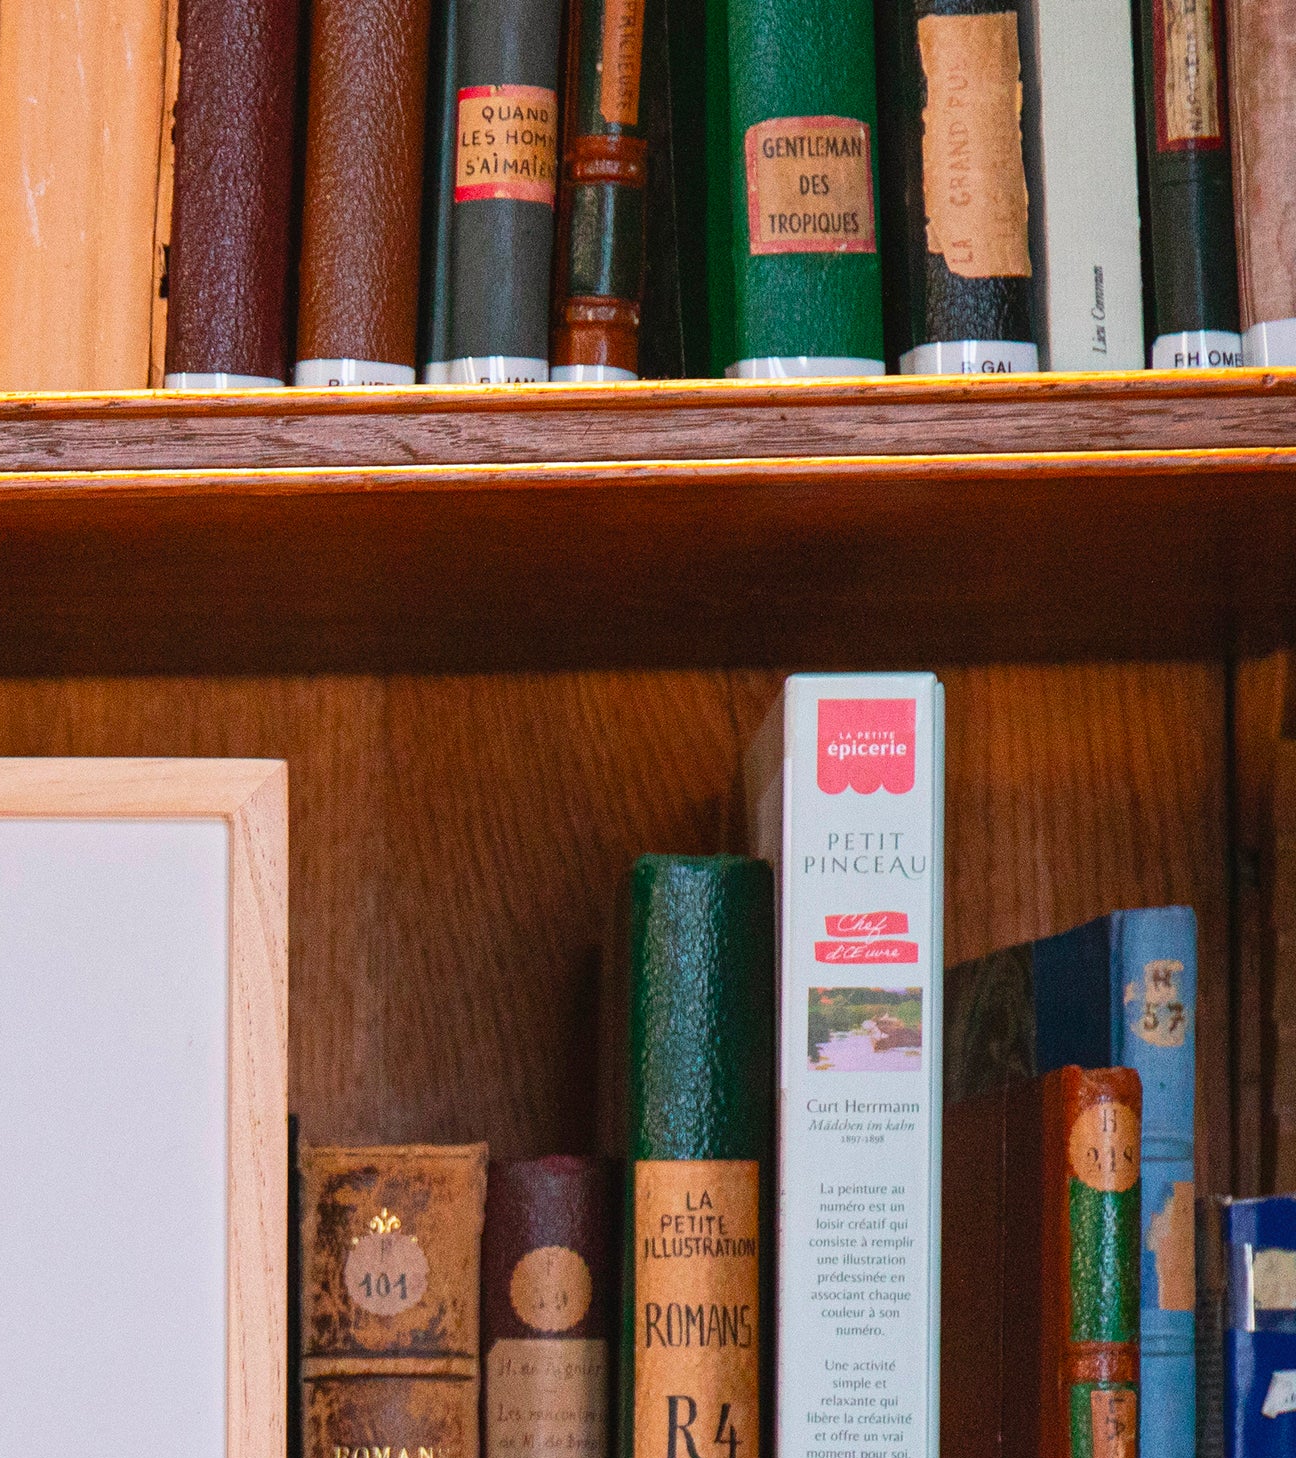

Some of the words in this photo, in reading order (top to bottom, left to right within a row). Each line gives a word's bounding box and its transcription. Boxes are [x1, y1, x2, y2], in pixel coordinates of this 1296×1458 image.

[482, 106, 548, 124] QUAND
[462, 130, 495, 147] LES
[763, 137, 863, 158] GENTLEMAN
[799, 174, 830, 195] DES
[768, 212, 859, 234] TROPIQUES
[857, 731, 895, 740] PETITE
[827, 740, 907, 761] épicerie
[828, 832, 904, 851] PETIT
[804, 855, 926, 880] PINCEAU
[837, 913, 888, 944] Chef
[806, 1099, 839, 1114] Curt
[845, 1099, 920, 1113] Herrmann
[807, 1118, 864, 1132] Mädchen
[867, 1120, 883, 1132] im
[886, 1119, 916, 1132] kahn
[840, 1134, 885, 1144] 1897-1898
[820, 1183, 834, 1194] La
[838, 1183, 888, 1197] peinture
[891, 1185, 905, 1195] au
[685, 1190, 713, 1212] LA
[819, 1201, 865, 1212] numéro
[869, 1203, 886, 1212] est
[890, 1203, 905, 1212] un
[660, 1215, 728, 1236] PETITE
[816, 1219, 844, 1229] loisir
[848, 1219, 886, 1230] créatif
[889, 1219, 908, 1232] qui
[644, 1236, 757, 1260] ILLUSTRATION
[808, 1236, 858, 1248] consiste
[861, 1237, 868, 1247] à
[871, 1236, 915, 1250] remplir
[816, 1255, 839, 1265] une
[842, 1254, 906, 1265] illustration
[358, 1272, 410, 1299] 101
[817, 1272, 887, 1285] prédessinée
[890, 1273, 906, 1283] en
[810, 1289, 865, 1300] associant
[868, 1289, 912, 1304] chaque
[821, 1306, 865, 1318] couleur
[868, 1307, 876, 1318] à
[879, 1308, 900, 1318] son
[644, 1301, 754, 1350] ROMANS
[835, 1324, 885, 1336] numéro.
